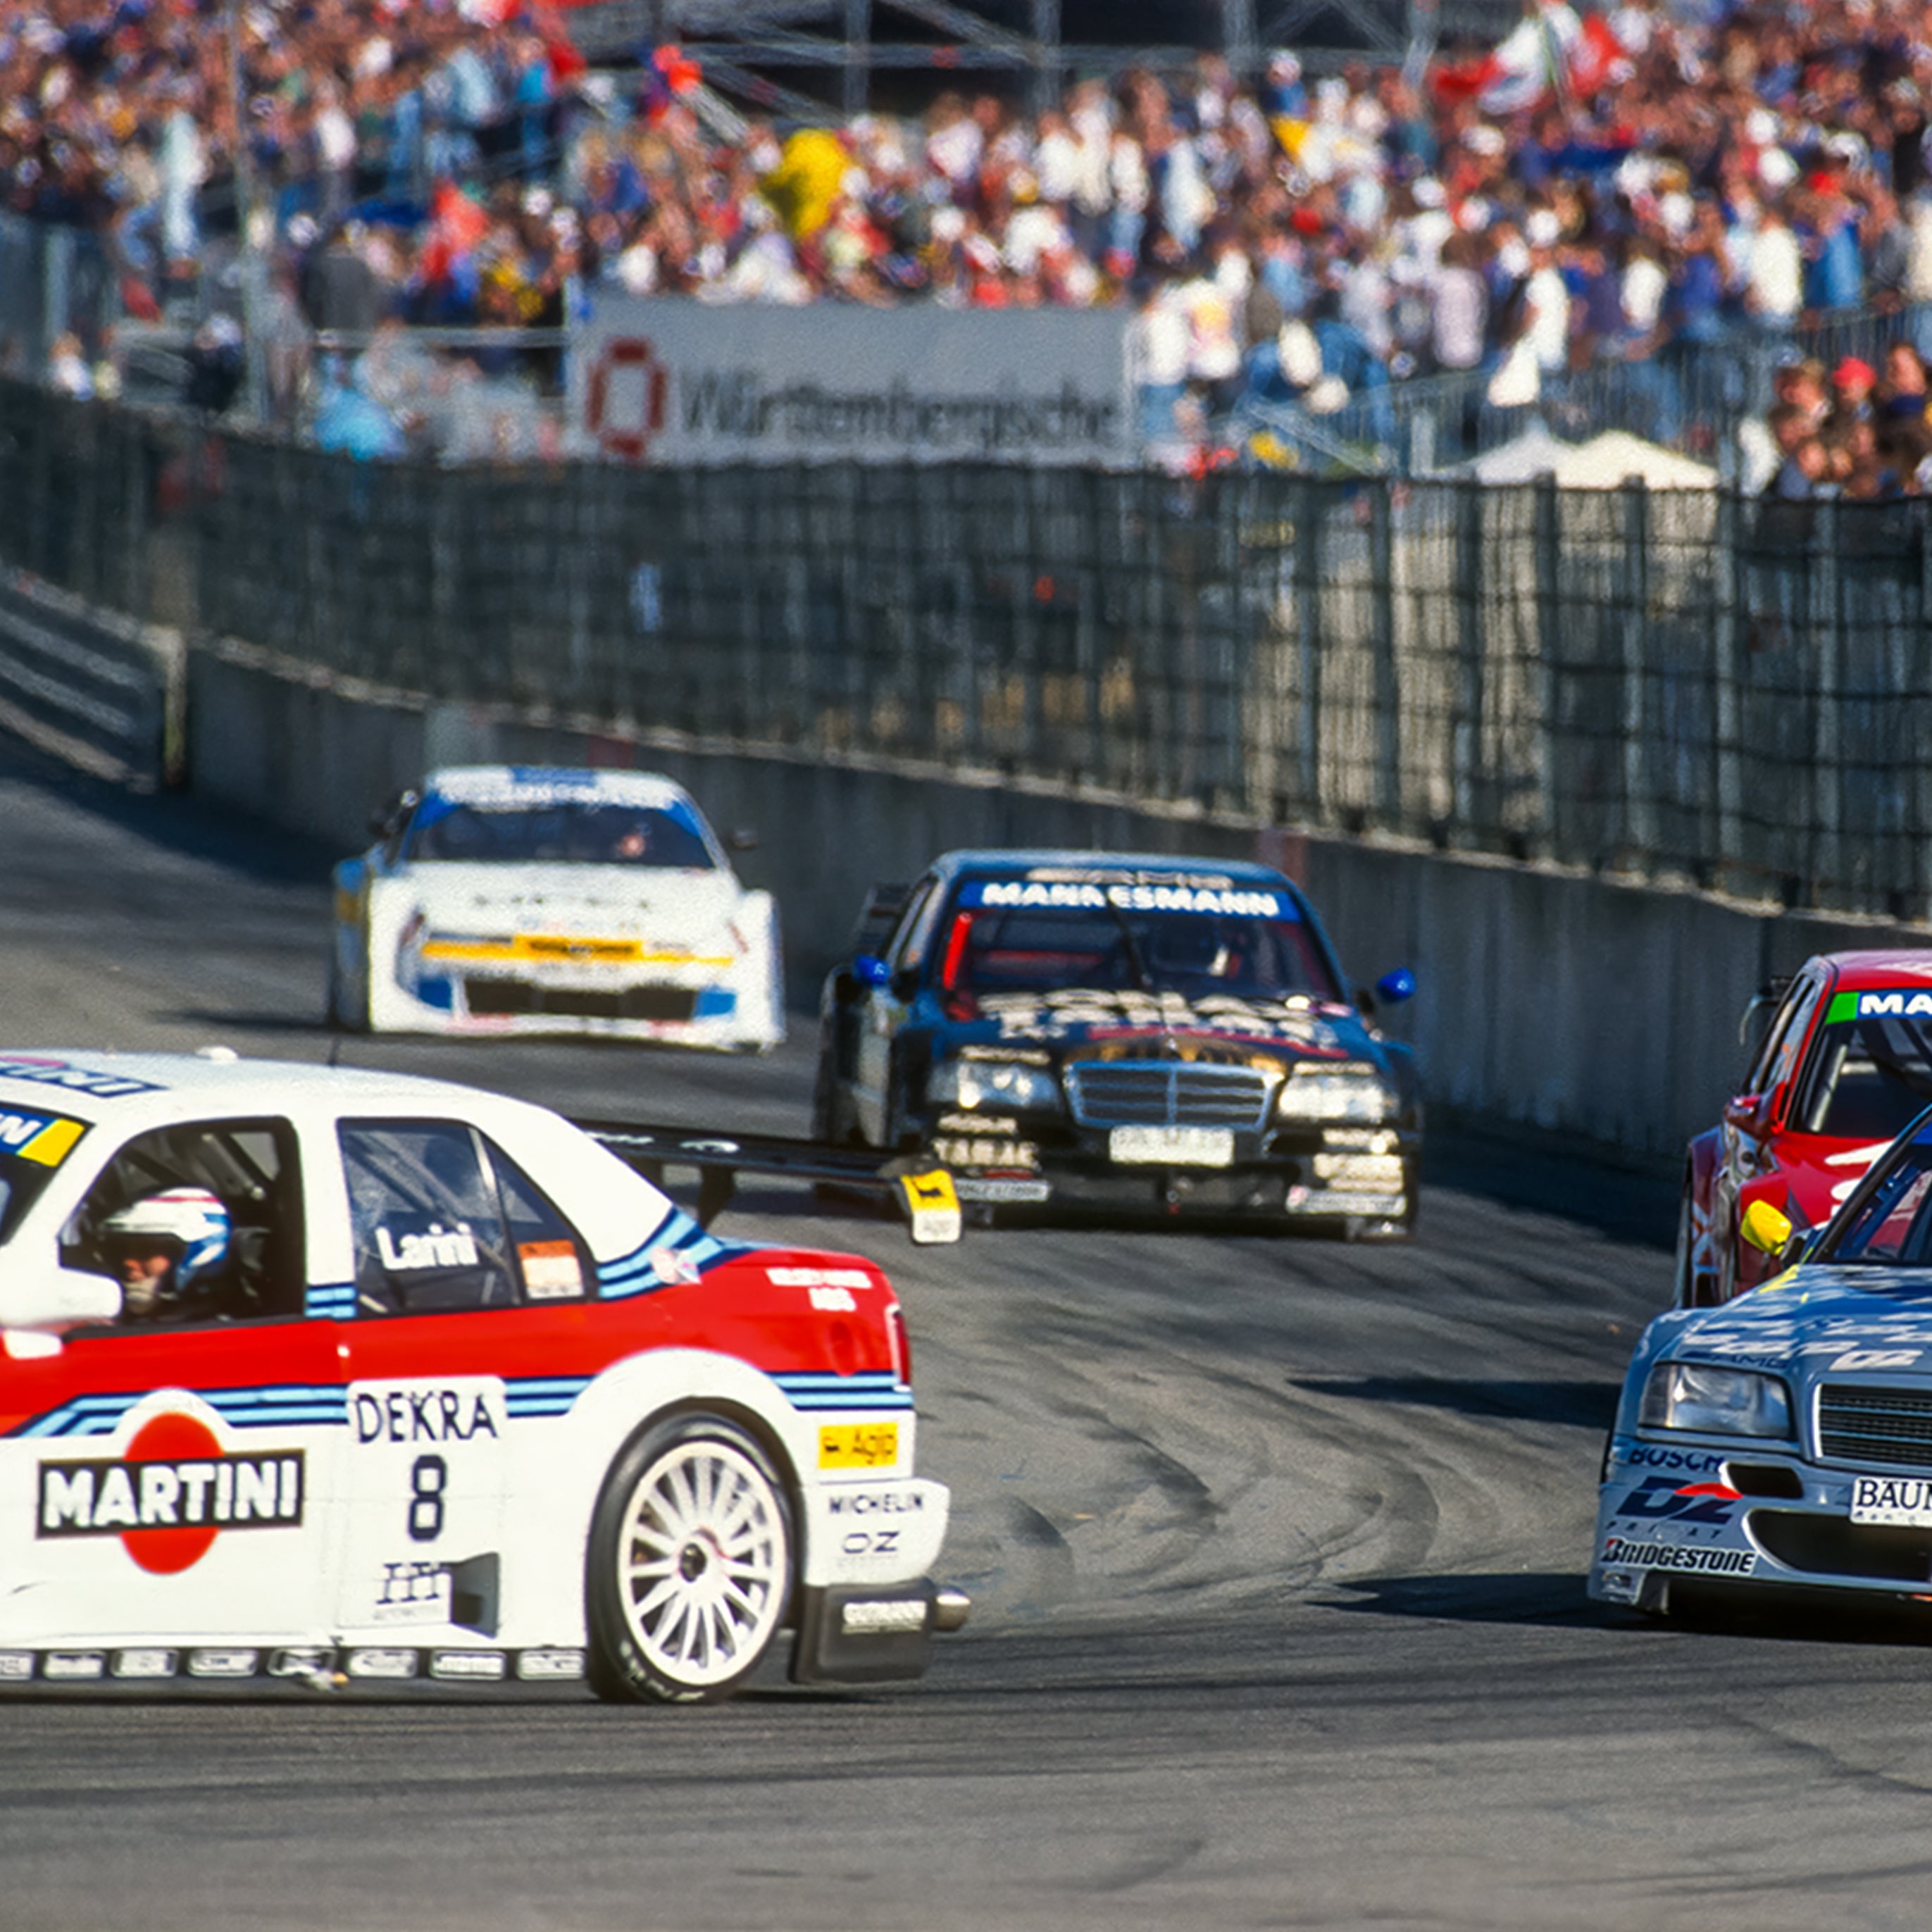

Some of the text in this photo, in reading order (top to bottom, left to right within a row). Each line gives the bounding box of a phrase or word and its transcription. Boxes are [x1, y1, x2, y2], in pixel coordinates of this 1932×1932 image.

[0, 1113, 42, 1145] N
[356, 1390, 498, 1443] DEKRA
[1629, 1447, 1726, 1472] BOSCH
[44, 1459, 298, 1528] MARTINI
[408, 1454, 447, 1543] 8
[1616, 1476, 1744, 1525] D2
[844, 1531, 900, 1554] OZ
[1601, 1539, 1756, 1573] BRIDGESTONE
